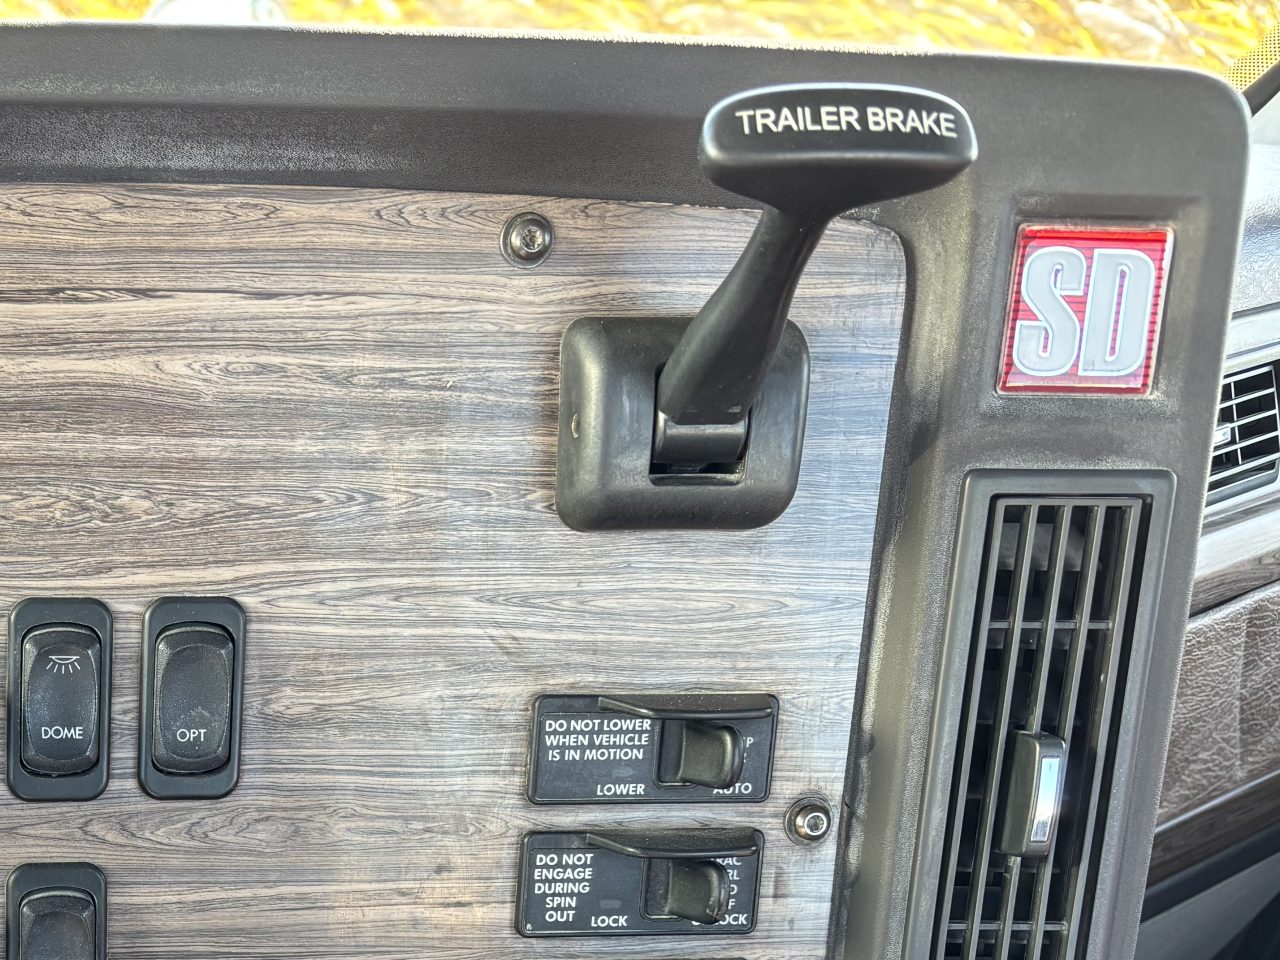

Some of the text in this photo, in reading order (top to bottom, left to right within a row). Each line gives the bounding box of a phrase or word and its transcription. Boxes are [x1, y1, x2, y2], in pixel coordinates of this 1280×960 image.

[735, 106, 957, 138] TRAILER BRAKE
[1011, 245, 1156, 377] SD
[546, 719, 651, 731] DO NOT LOWER
[42, 726, 83, 739] DOME
[177, 729, 206, 741] OPT
[545, 734, 649, 746] WHEN VEHICLE
[549, 749, 643, 761] IS IN MOTION
[597, 784, 644, 795] LOWER
[536, 854, 593, 865] DO NOT
[534, 868, 592, 879] ENGAGE
[535, 882, 589, 893] DURING
[546, 897, 576, 907] SPIN
[545, 911, 575, 922] OUT
[591, 916, 628, 927] LOCK
